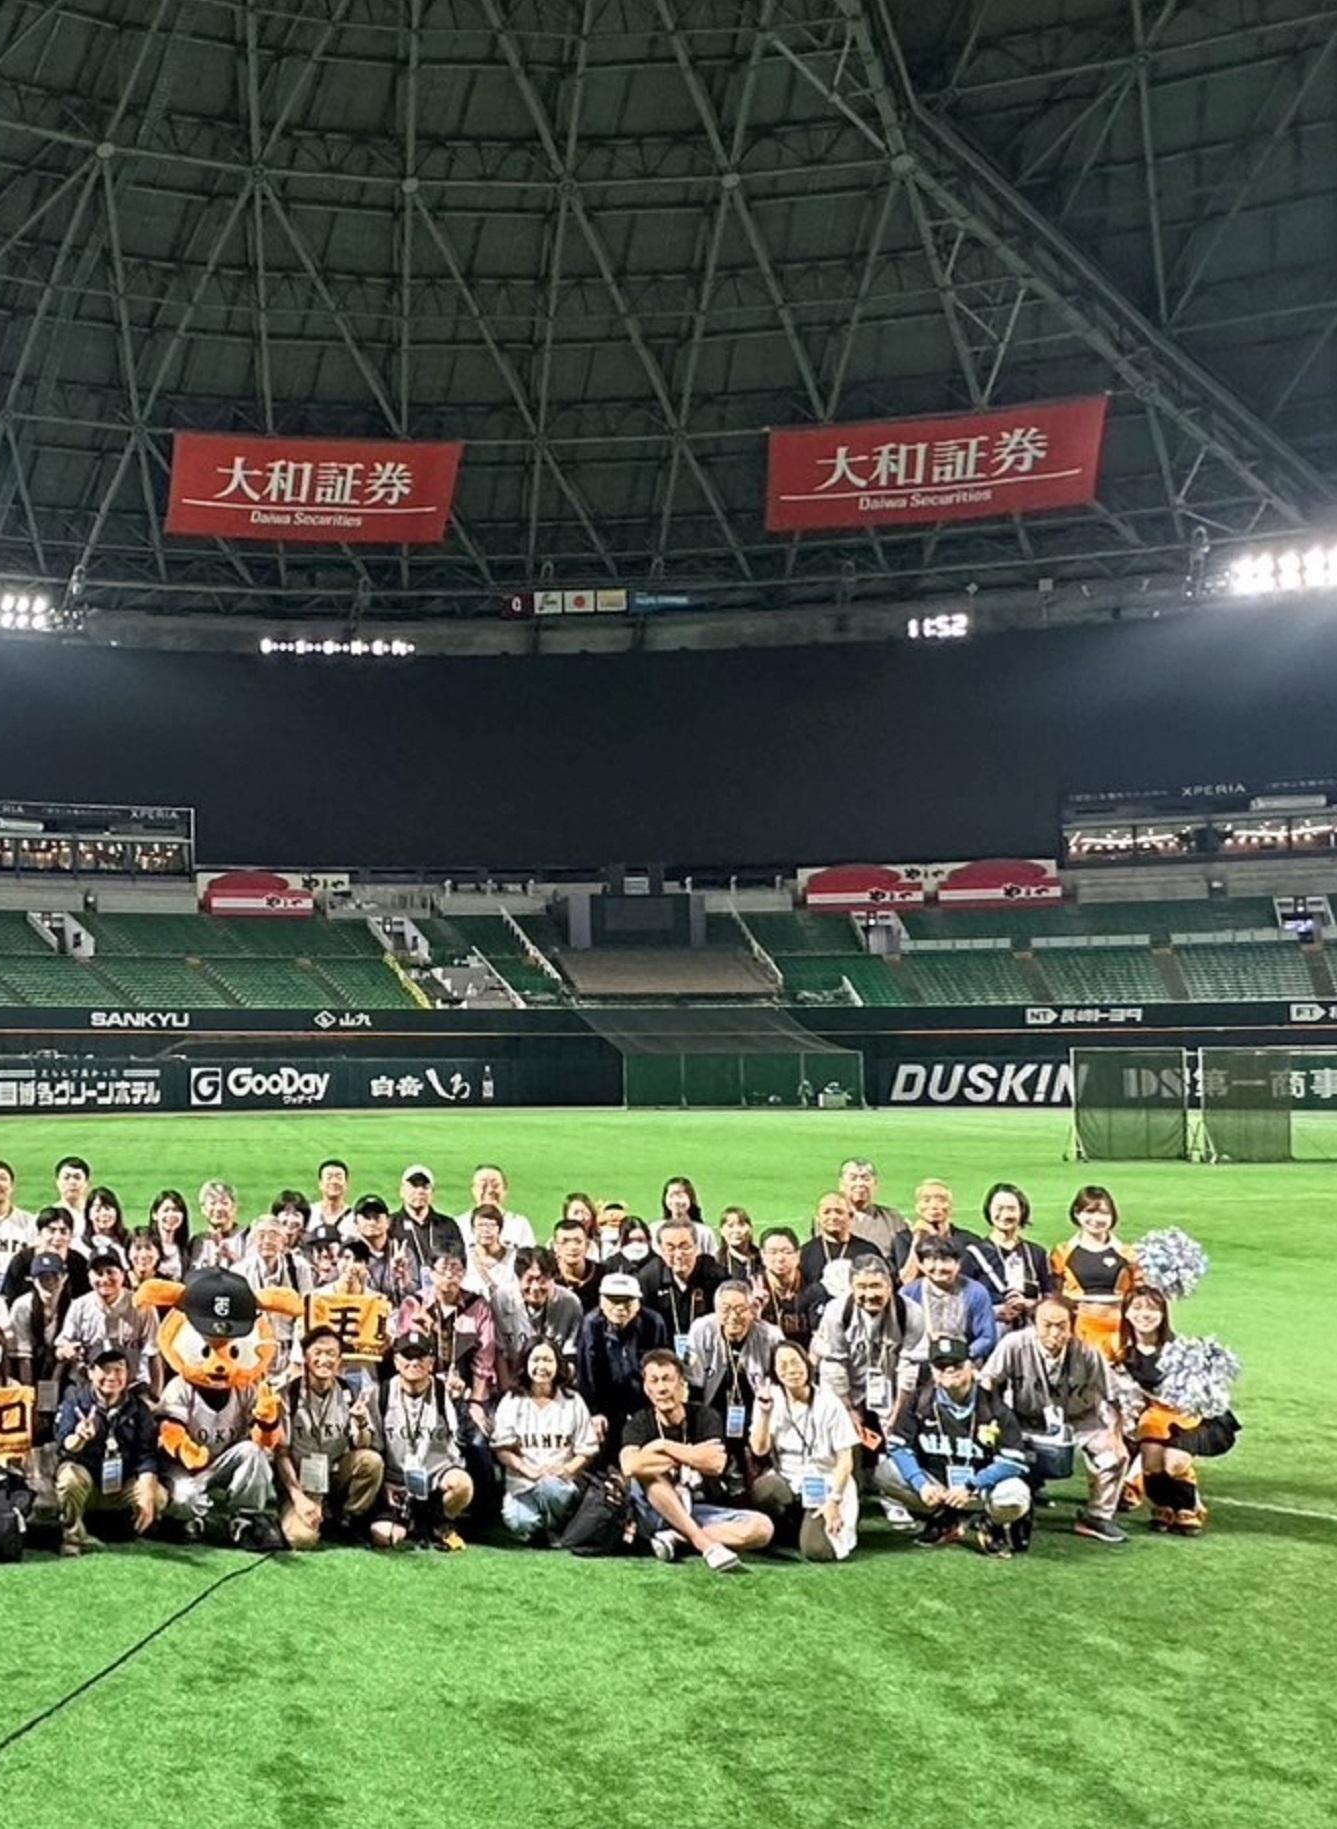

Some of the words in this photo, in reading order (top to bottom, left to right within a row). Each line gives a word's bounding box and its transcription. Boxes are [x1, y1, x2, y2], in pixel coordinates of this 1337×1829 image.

[815, 426, 1048, 491] 大和証券
[214, 456, 412, 505] 大和証券
[858, 494, 906, 511] Daiwa
[910, 488, 992, 507] Securities
[250, 510, 291, 525] Daiwa
[294, 511, 362, 527] Securities
[1181, 783, 1246, 797] XPERIA
[128, 810, 178, 820] XPERIA
[90, 1012, 189, 1028] SANKYU
[339, 1013, 371, 1027] 山九
[227, 1067, 330, 1101] GooDay
